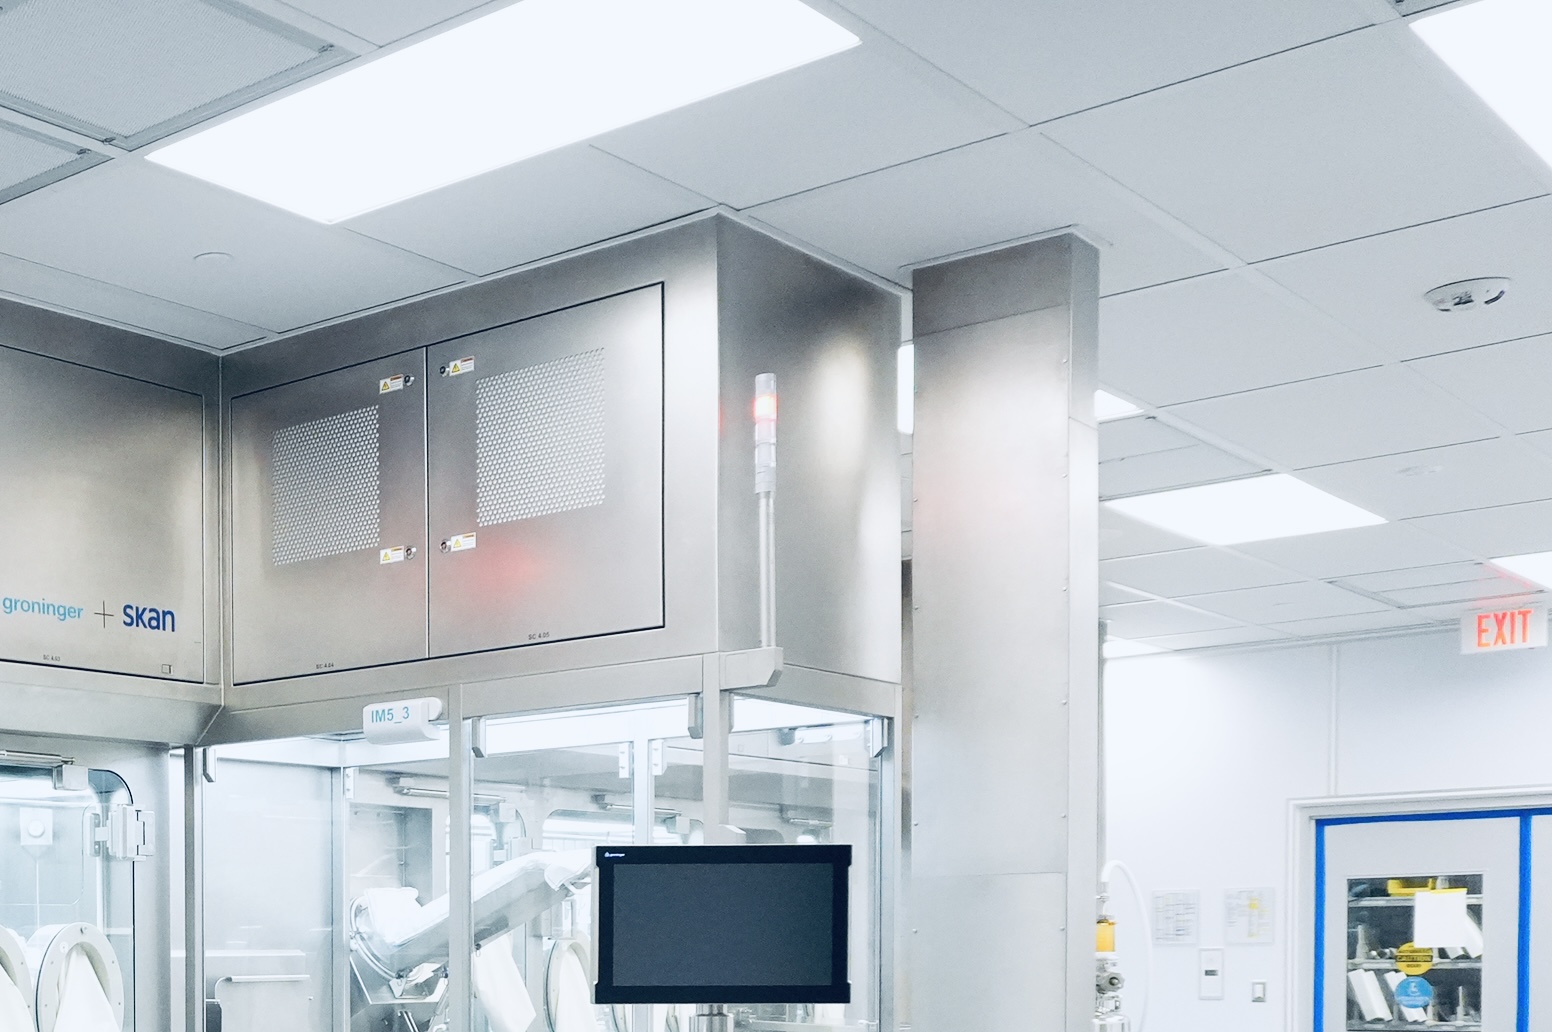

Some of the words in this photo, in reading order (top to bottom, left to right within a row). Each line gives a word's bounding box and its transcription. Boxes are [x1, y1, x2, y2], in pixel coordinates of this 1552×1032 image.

[2, 596, 84, 622] groninger
[528, 633, 537, 641] SC
[1476, 609, 1533, 648] EXIT
[371, 706, 410, 724] IM5_3
